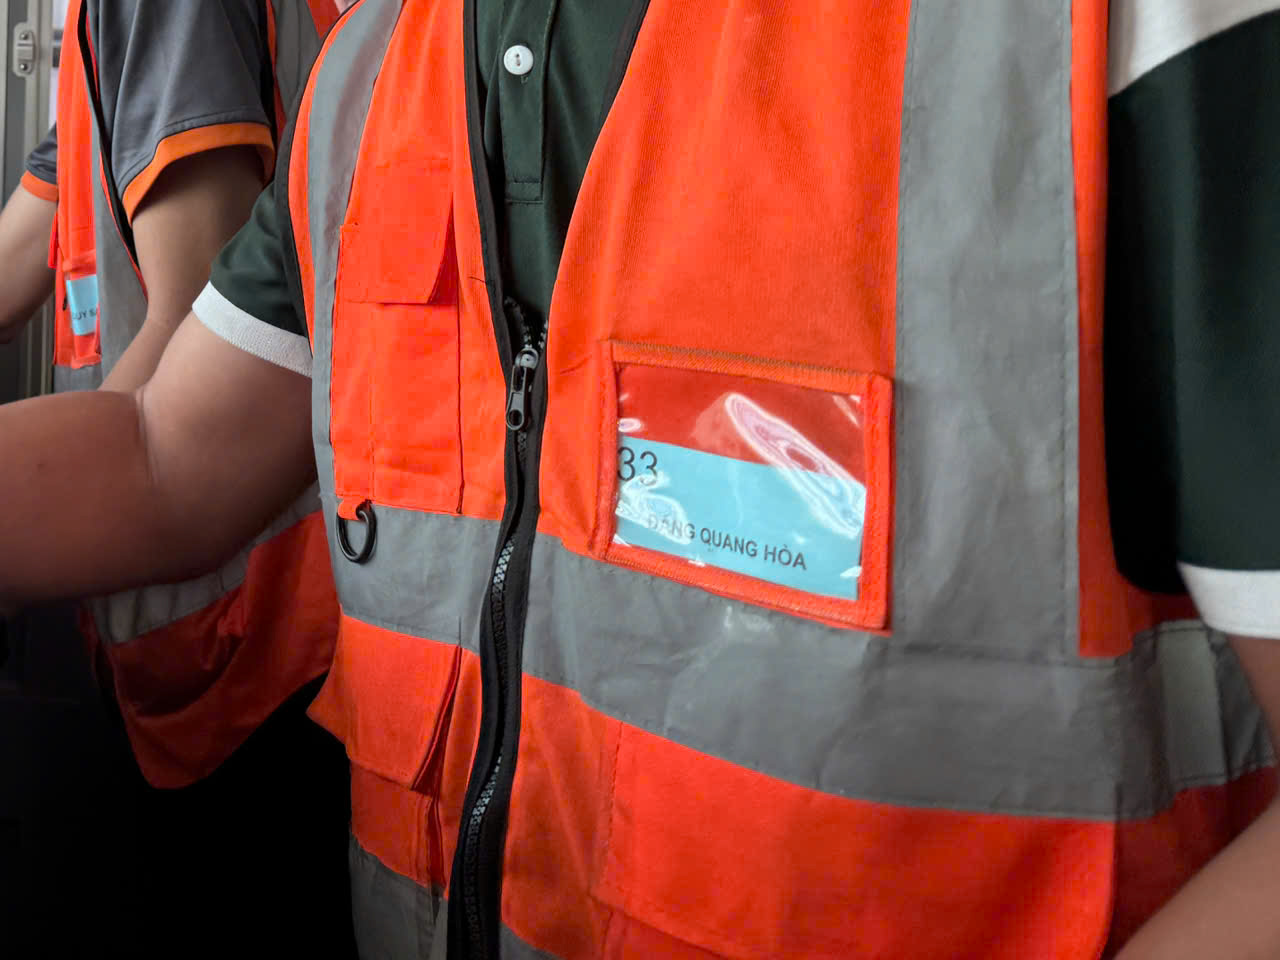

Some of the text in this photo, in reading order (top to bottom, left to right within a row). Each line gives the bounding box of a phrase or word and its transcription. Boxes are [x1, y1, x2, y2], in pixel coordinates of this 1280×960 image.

[616, 445, 658, 487] 33
[700, 527, 758, 558] QUANG
[764, 543, 807, 571] HÒA
